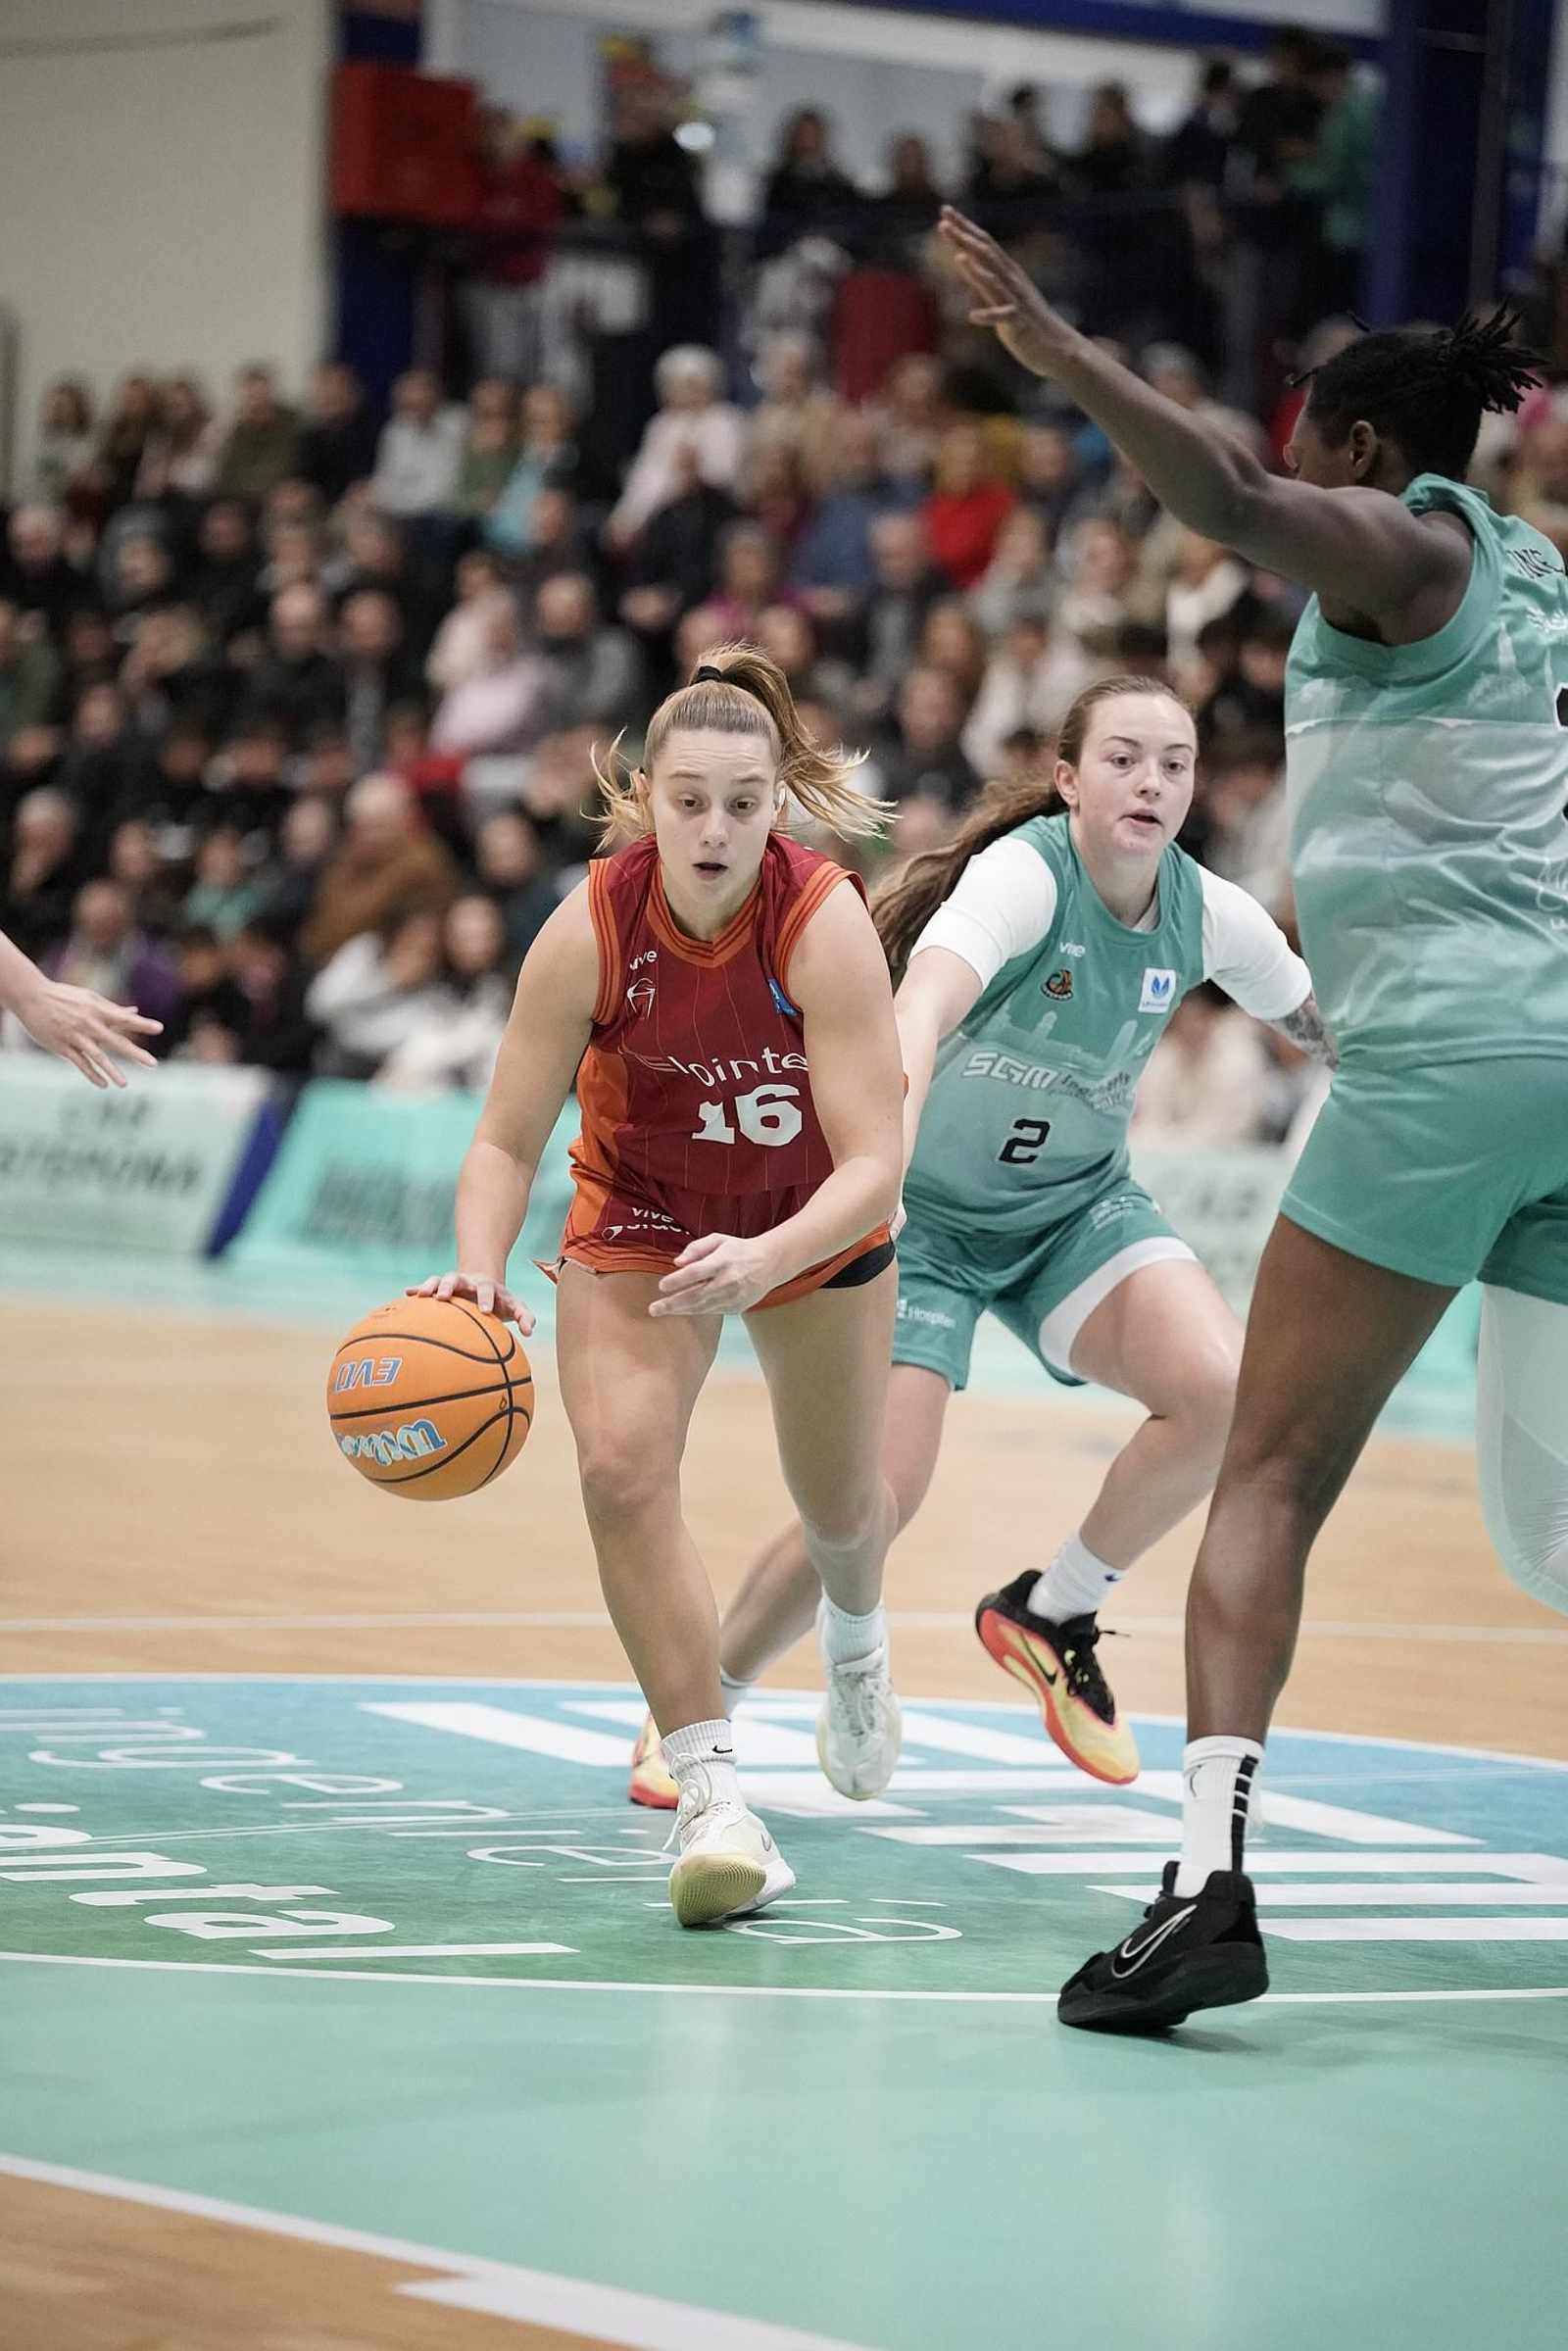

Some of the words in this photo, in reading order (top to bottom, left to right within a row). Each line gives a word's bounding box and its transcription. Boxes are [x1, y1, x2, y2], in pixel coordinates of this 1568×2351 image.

[963, 1052, 1058, 1089] SGM
[691, 1084, 802, 1147] 16
[997, 1117, 1052, 1165] 2
